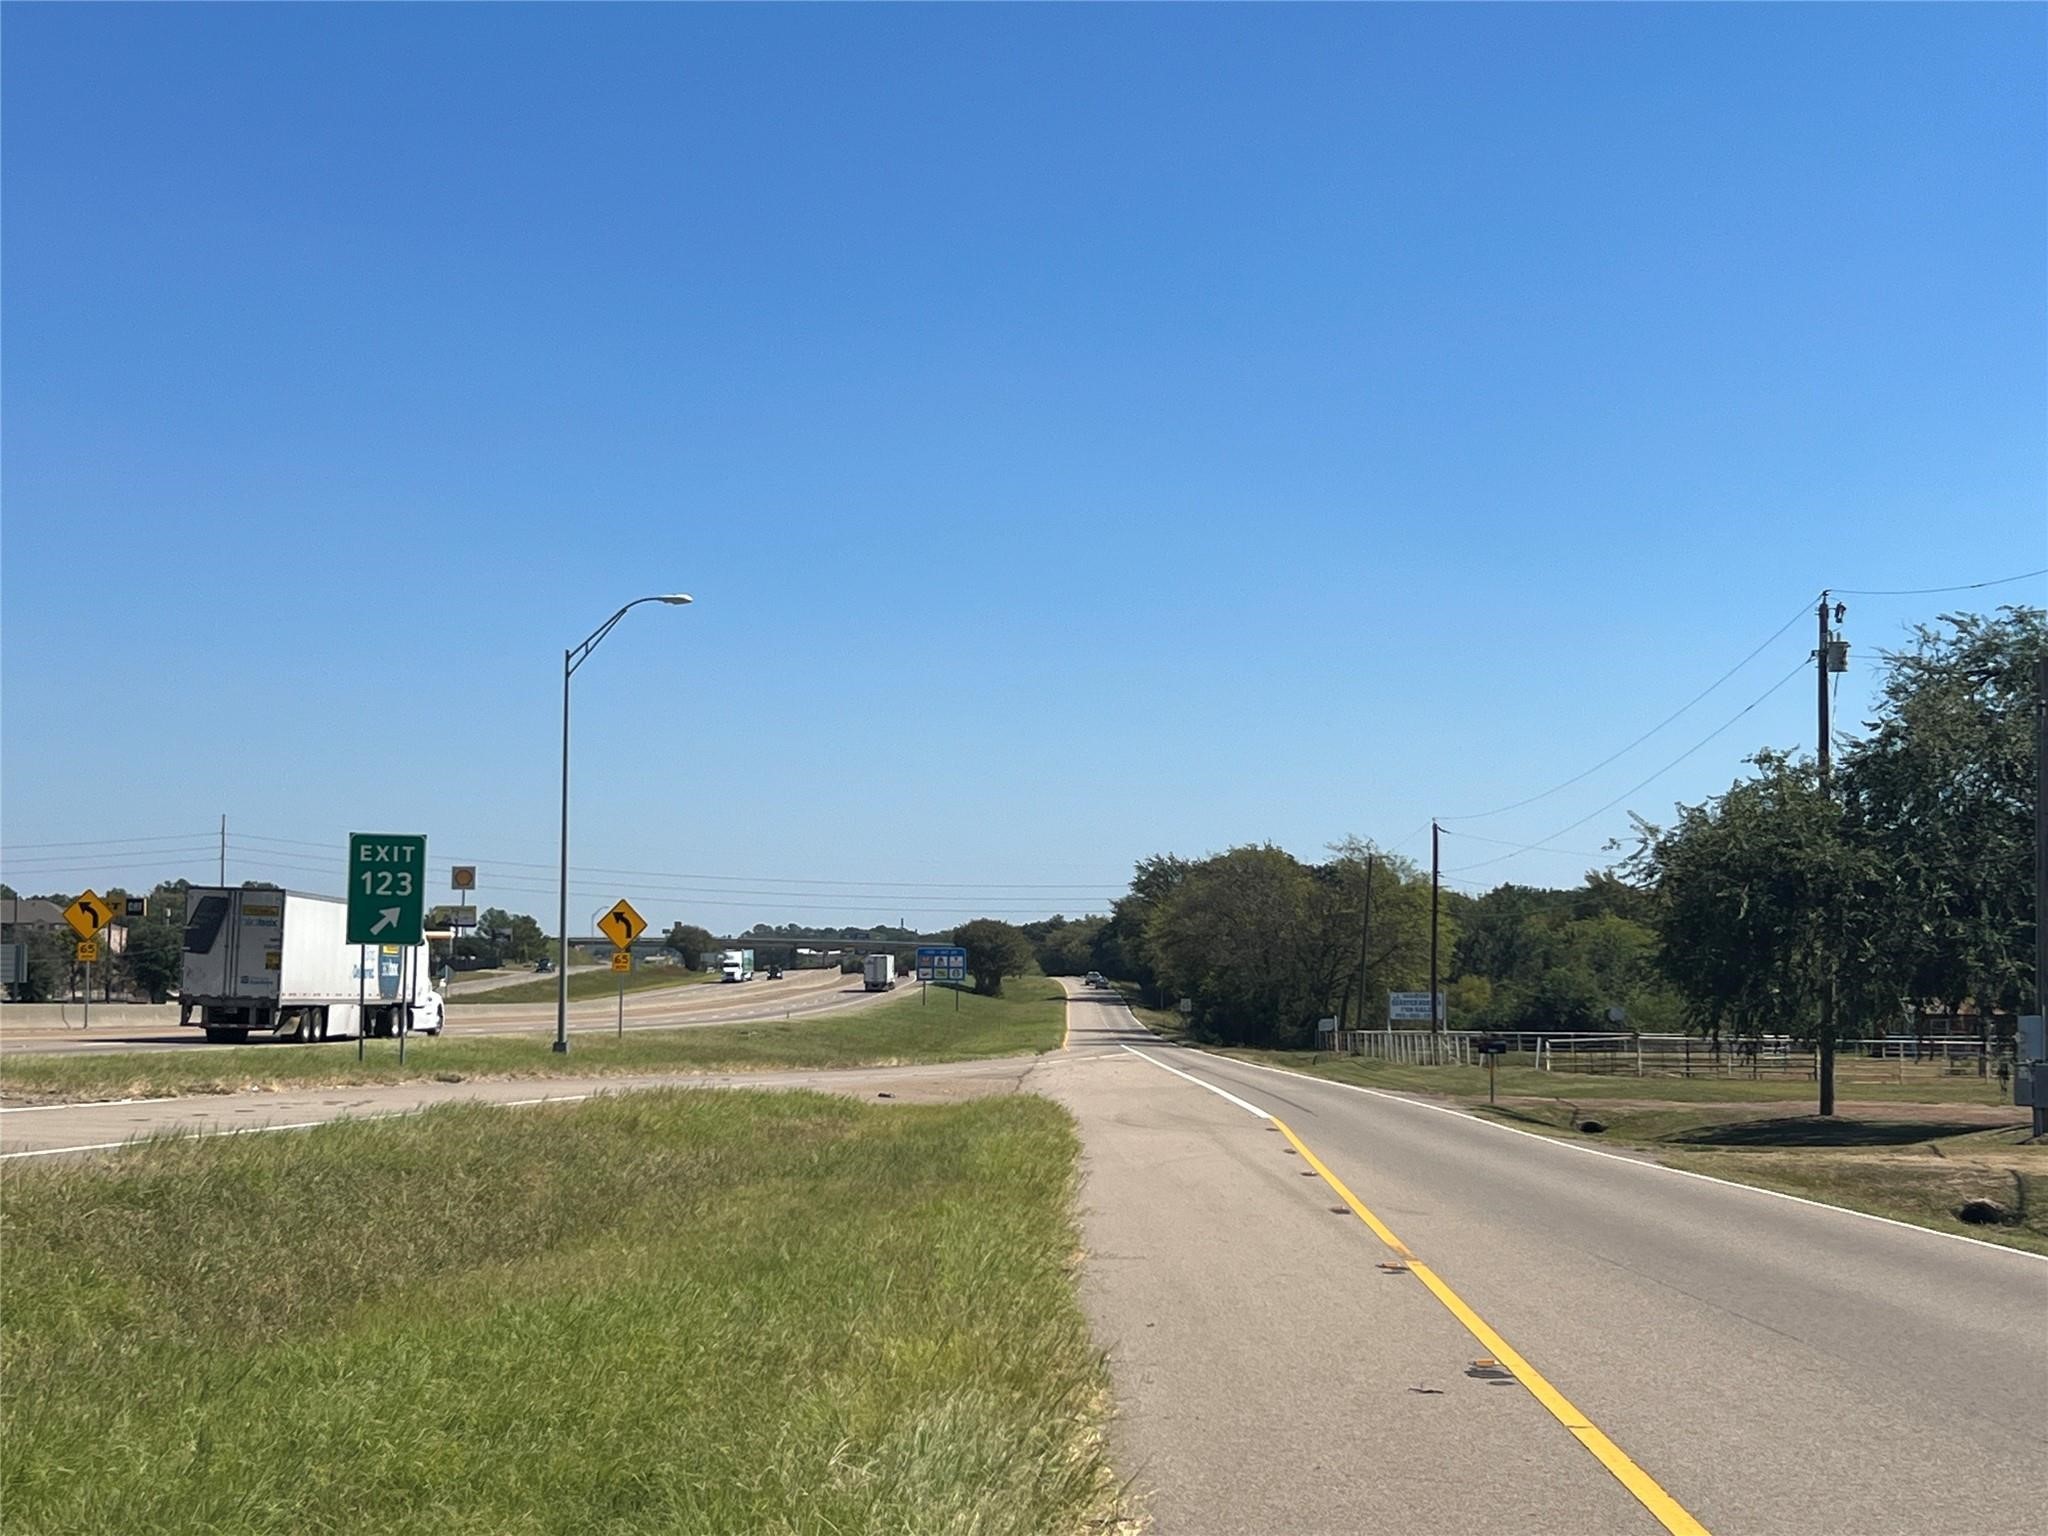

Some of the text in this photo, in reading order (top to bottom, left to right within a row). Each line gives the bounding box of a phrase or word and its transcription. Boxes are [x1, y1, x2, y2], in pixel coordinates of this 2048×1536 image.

[360, 845, 416, 863] EXIT
[360, 871, 413, 896] 123
[80, 944, 95, 953] 65
[614, 954, 629, 964] 65
